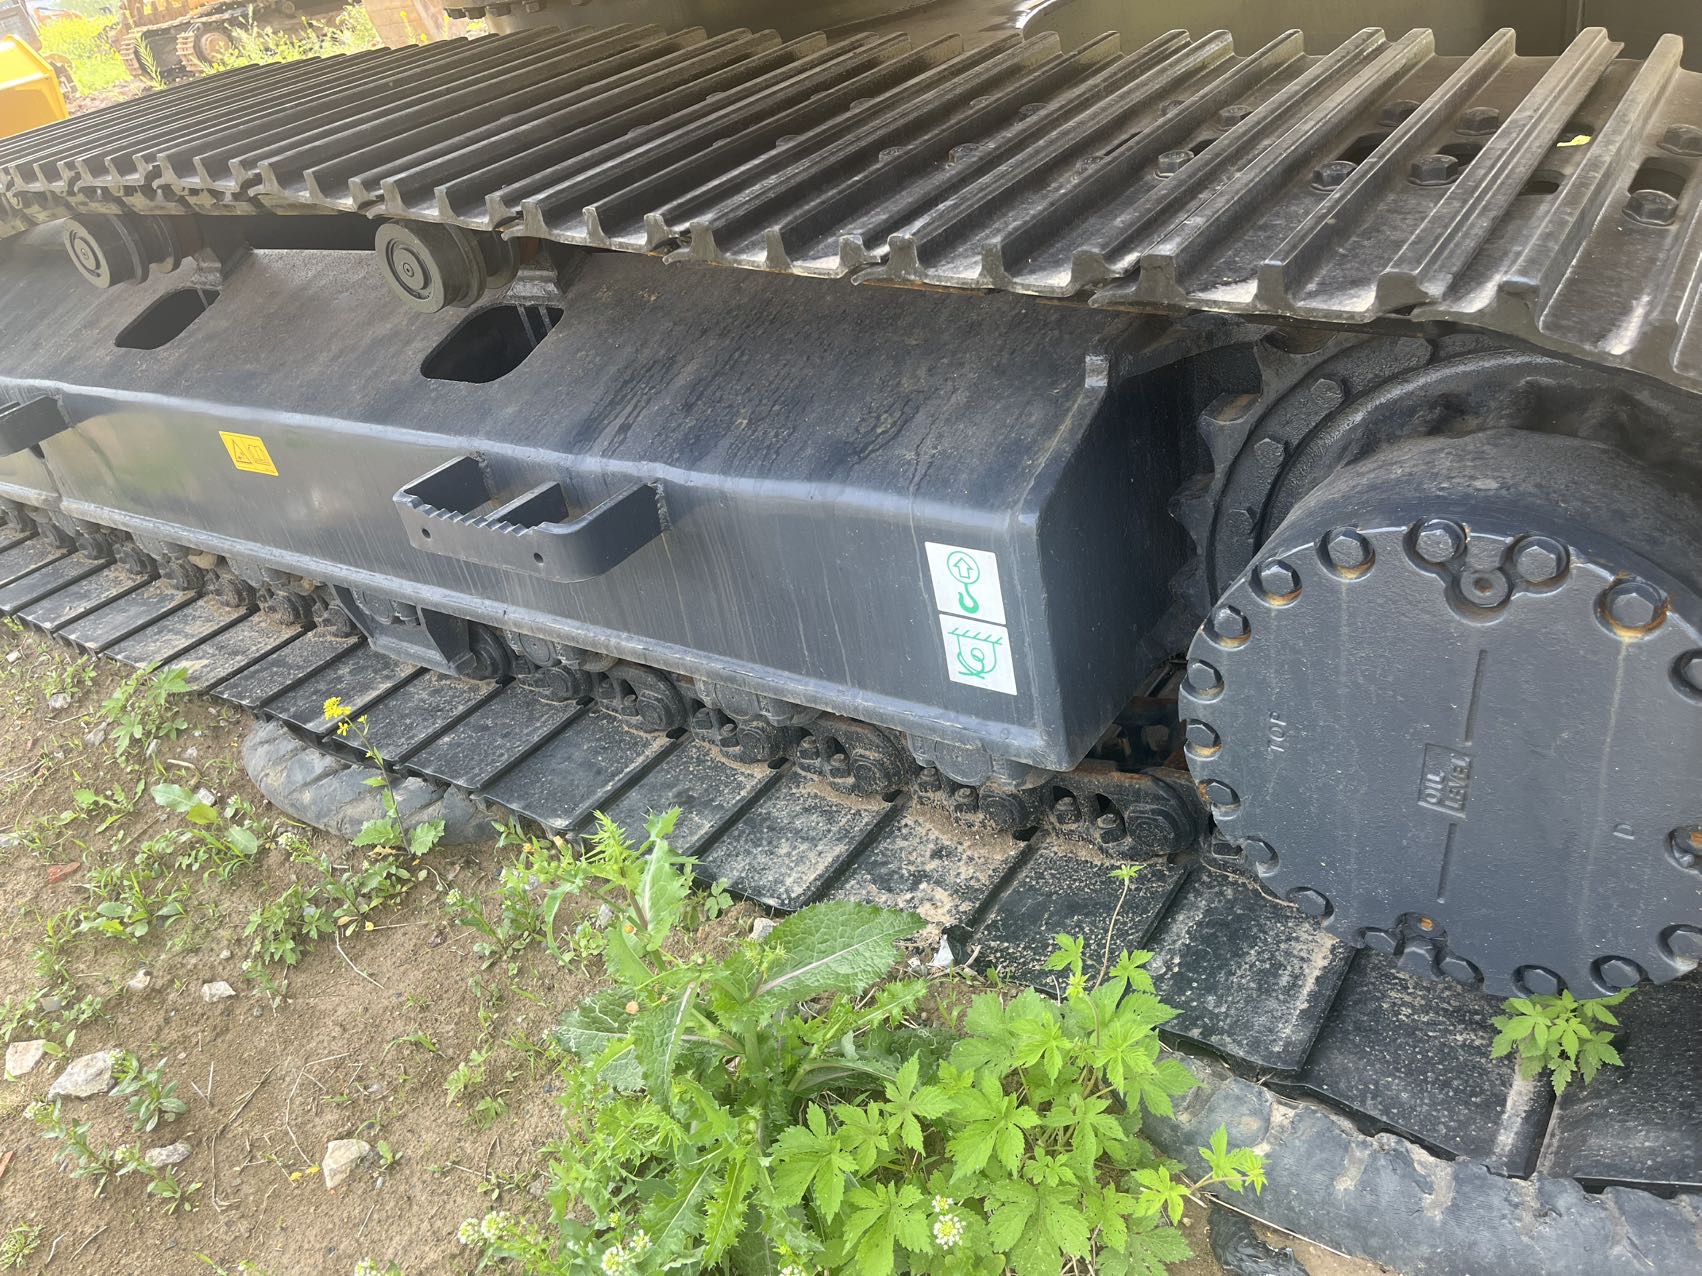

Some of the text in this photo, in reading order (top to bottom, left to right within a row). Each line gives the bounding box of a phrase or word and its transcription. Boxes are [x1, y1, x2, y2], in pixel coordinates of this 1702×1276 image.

[1268, 711, 1287, 752] TOP
[1425, 770, 1445, 803] OIL
[1444, 756, 1471, 809] LEVEL
